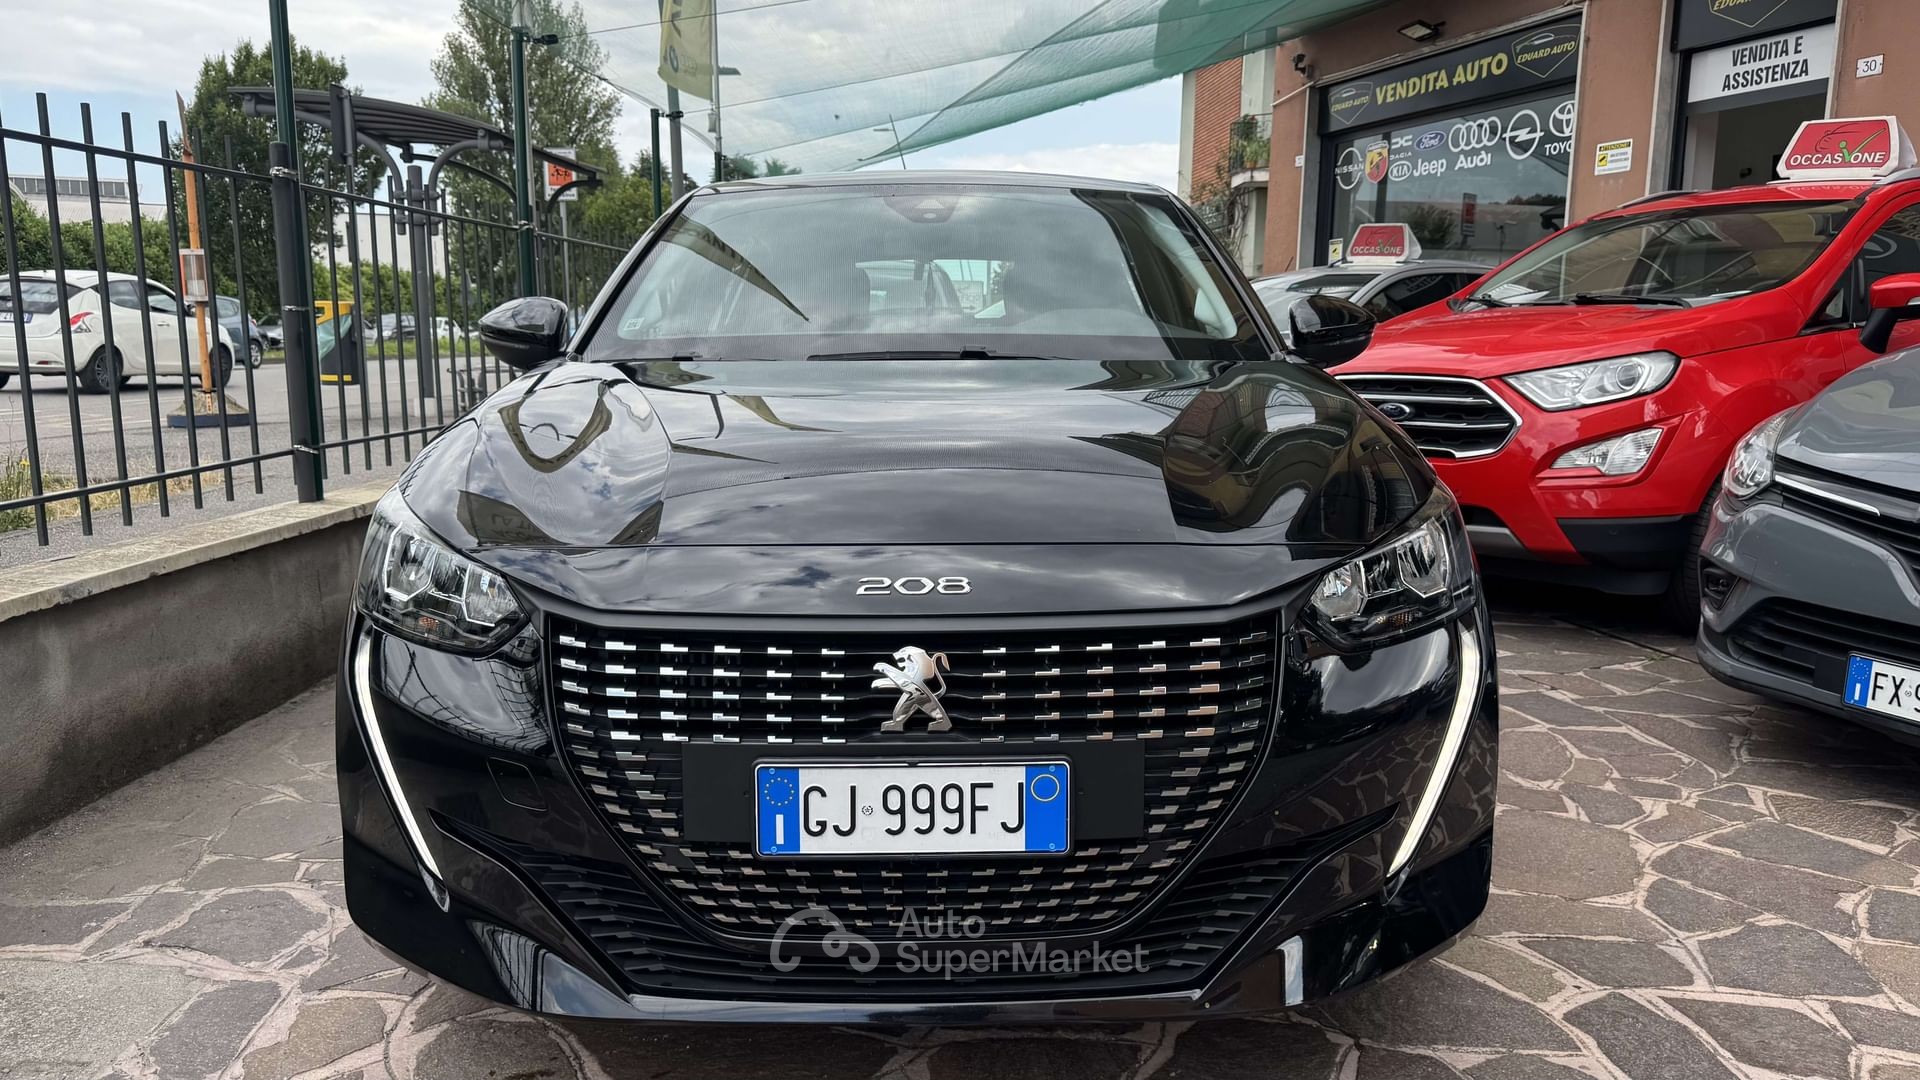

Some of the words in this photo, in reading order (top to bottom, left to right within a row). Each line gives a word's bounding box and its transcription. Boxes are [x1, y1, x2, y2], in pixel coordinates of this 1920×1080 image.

[1517, 48, 1551, 64] EDUARD
[1551, 40, 1576, 55] AUTO
[1732, 38, 1789, 67] VENDITA
[1794, 35, 1804, 55] E
[1721, 58, 1809, 92] ASSISTENZA
[1862, 59, 1877, 73] 30
[1375, 69, 1449, 105] VENDITA
[1453, 52, 1509, 87] AUTO
[1419, 132, 1442, 149] Ford
[1454, 152, 1491, 171] Audi
[1790, 142, 1885, 166] OCCASIONE
[1334, 162, 1364, 174] NISSAN
[1392, 165, 1409, 177] KIA
[1413, 158, 1447, 177] Jeep
[1352, 242, 1403, 255] OCCASIONE
[856, 576, 972, 596] 208
[1871, 671, 1906, 707] FX
[803, 784, 857, 837] GJ
[882, 781, 1025, 836] 999FJ
